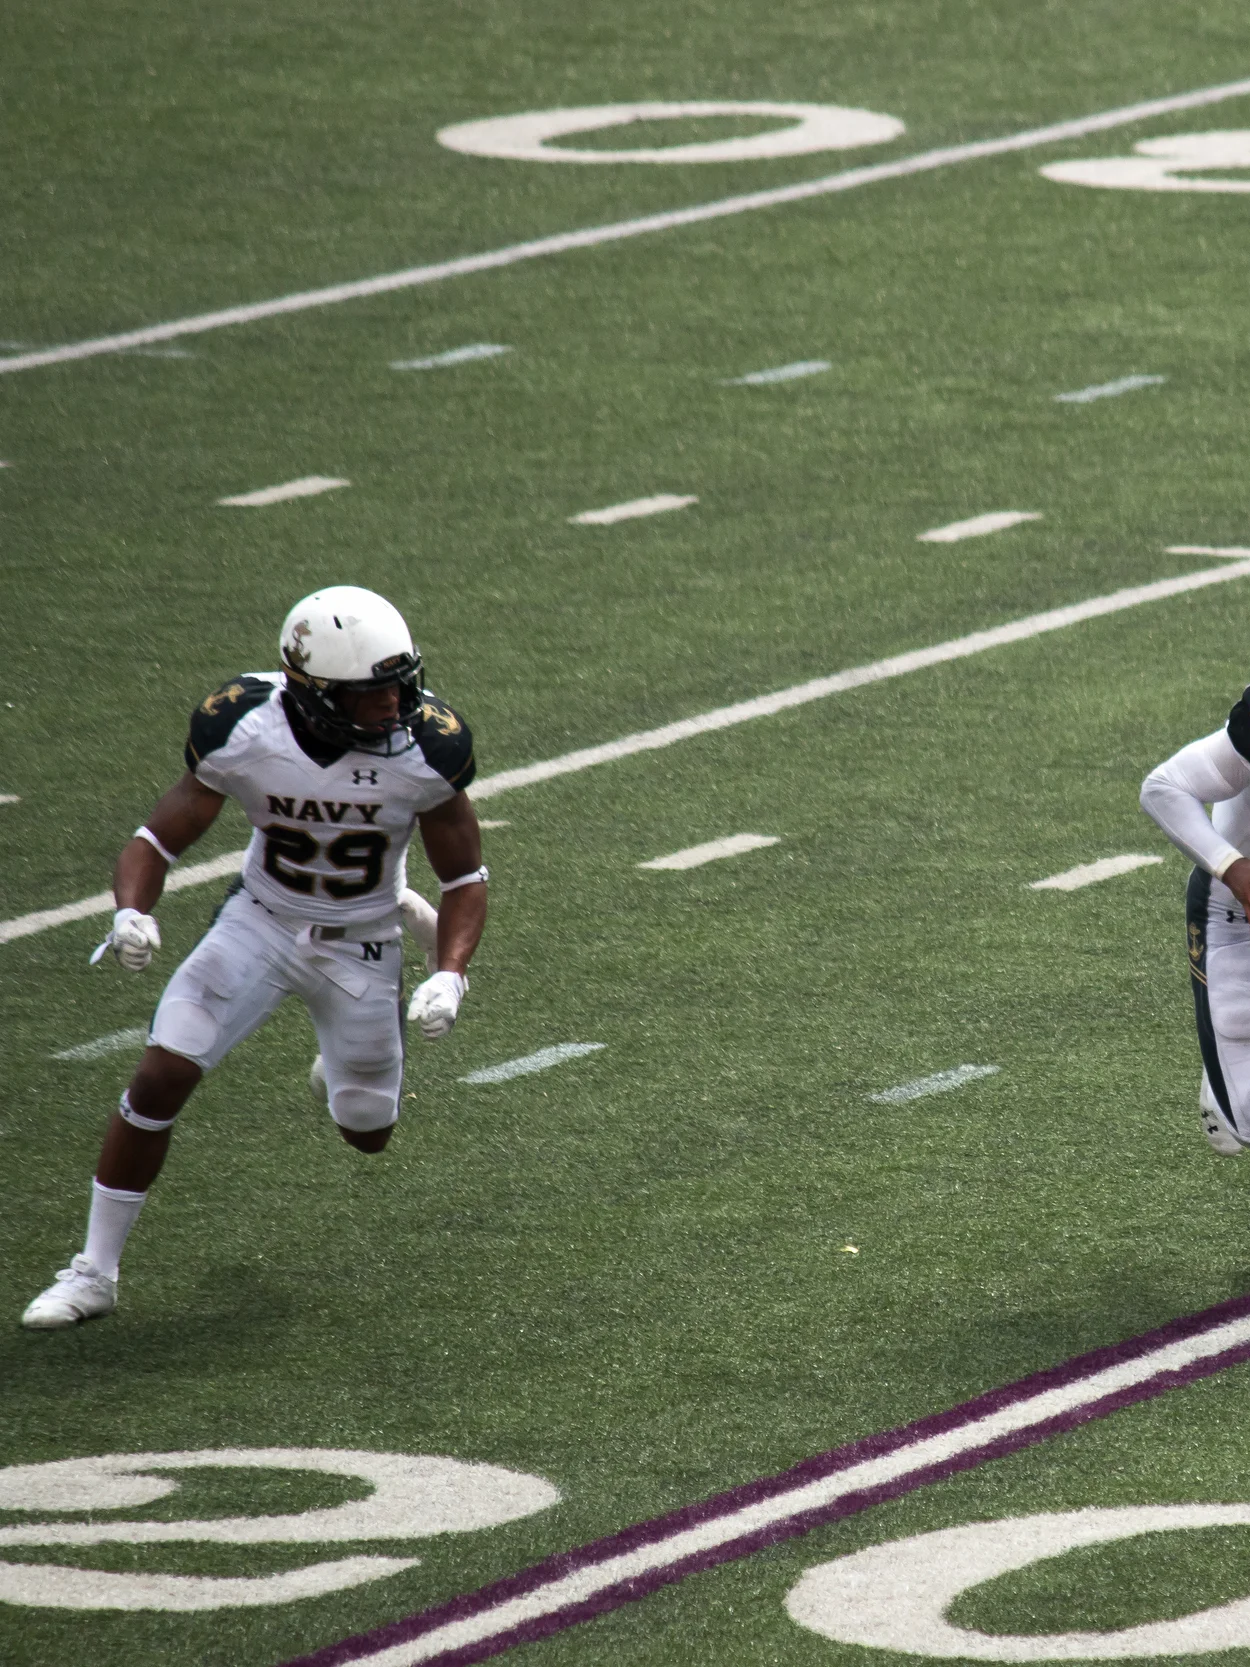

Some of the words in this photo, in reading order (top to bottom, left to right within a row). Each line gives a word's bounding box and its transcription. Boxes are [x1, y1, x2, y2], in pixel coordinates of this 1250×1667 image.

[266, 795, 383, 825] NAVY
[261, 822, 391, 899] 29
[361, 941, 384, 962] N
